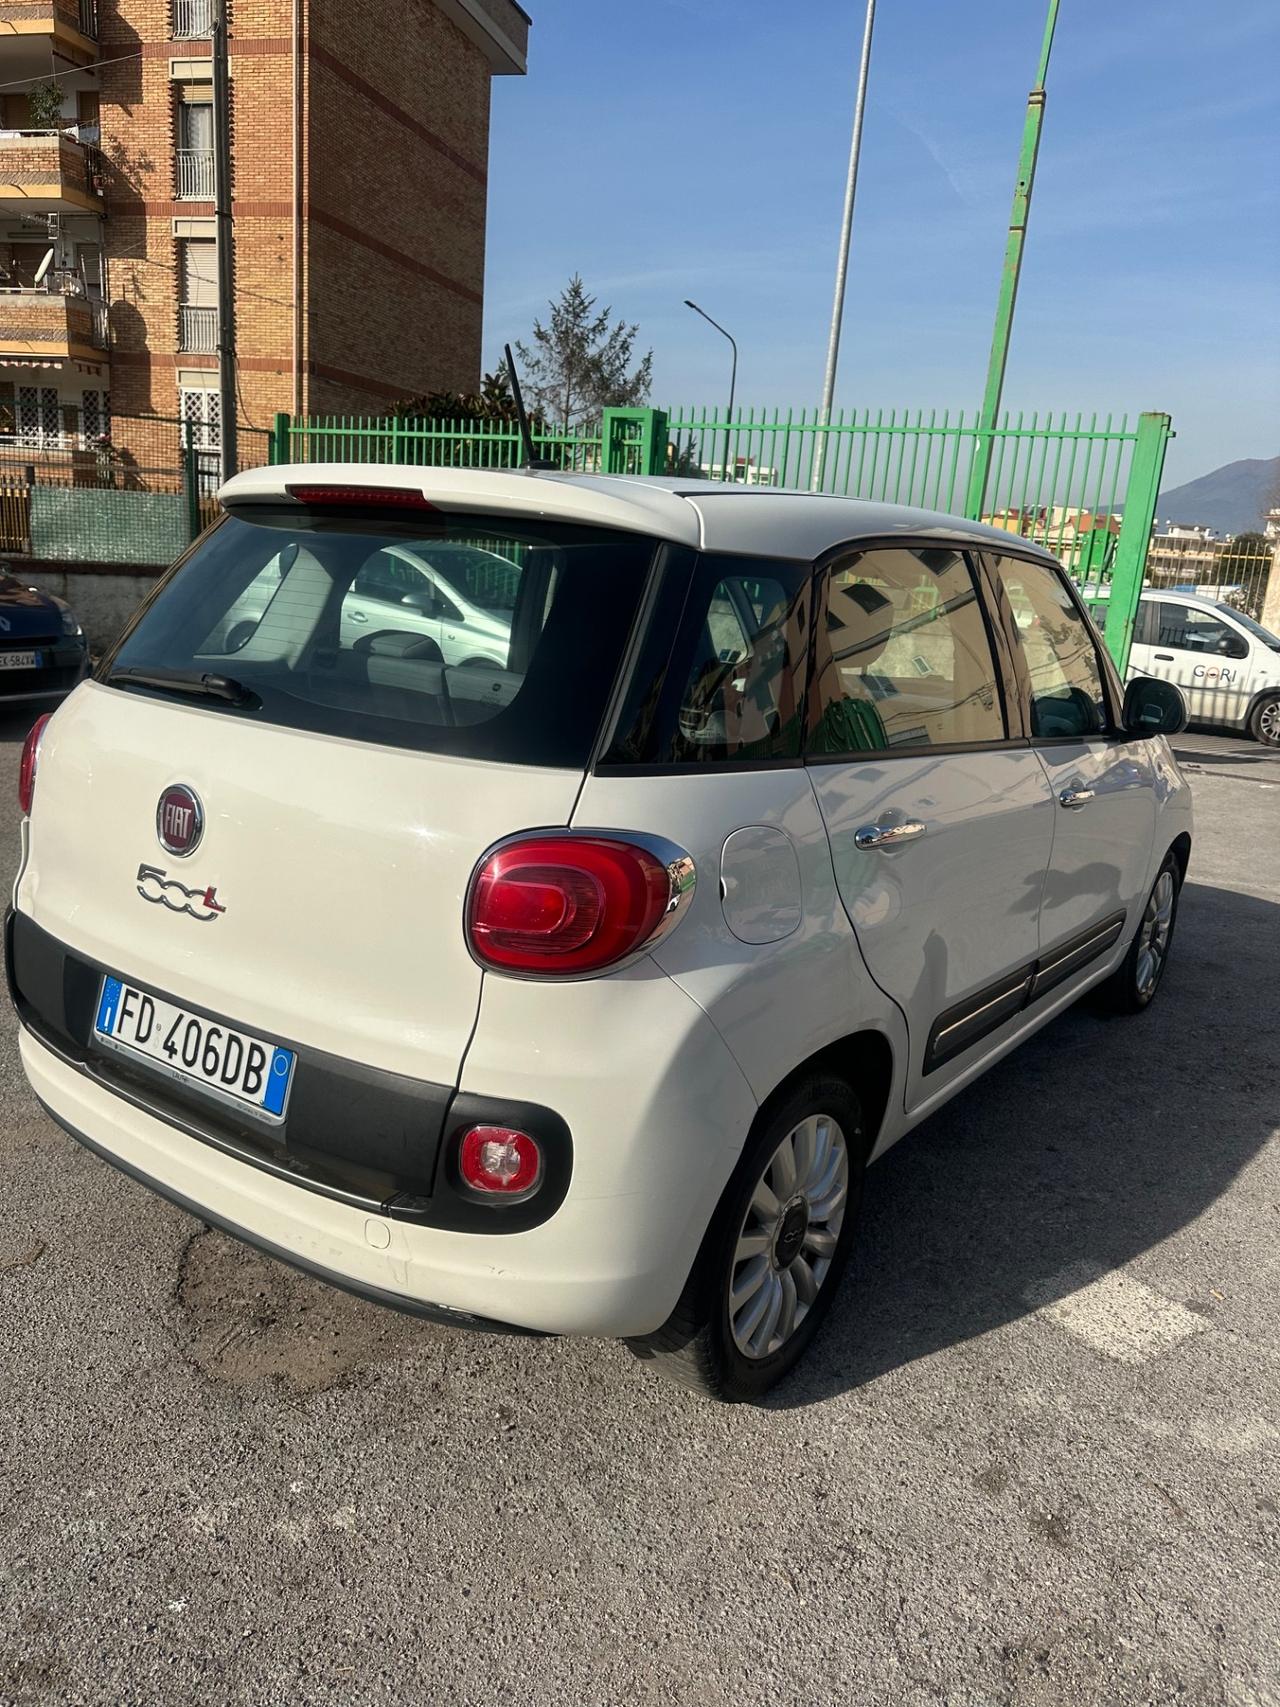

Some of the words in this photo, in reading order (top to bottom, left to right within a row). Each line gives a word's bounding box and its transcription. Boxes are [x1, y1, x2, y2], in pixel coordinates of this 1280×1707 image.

[1193, 665, 1237, 682] GORI
[164, 803, 192, 839] FIAT
[137, 863, 226, 922] 500L
[117, 988, 155, 1044] FD
[162, 1013, 266, 1095] 406DB
